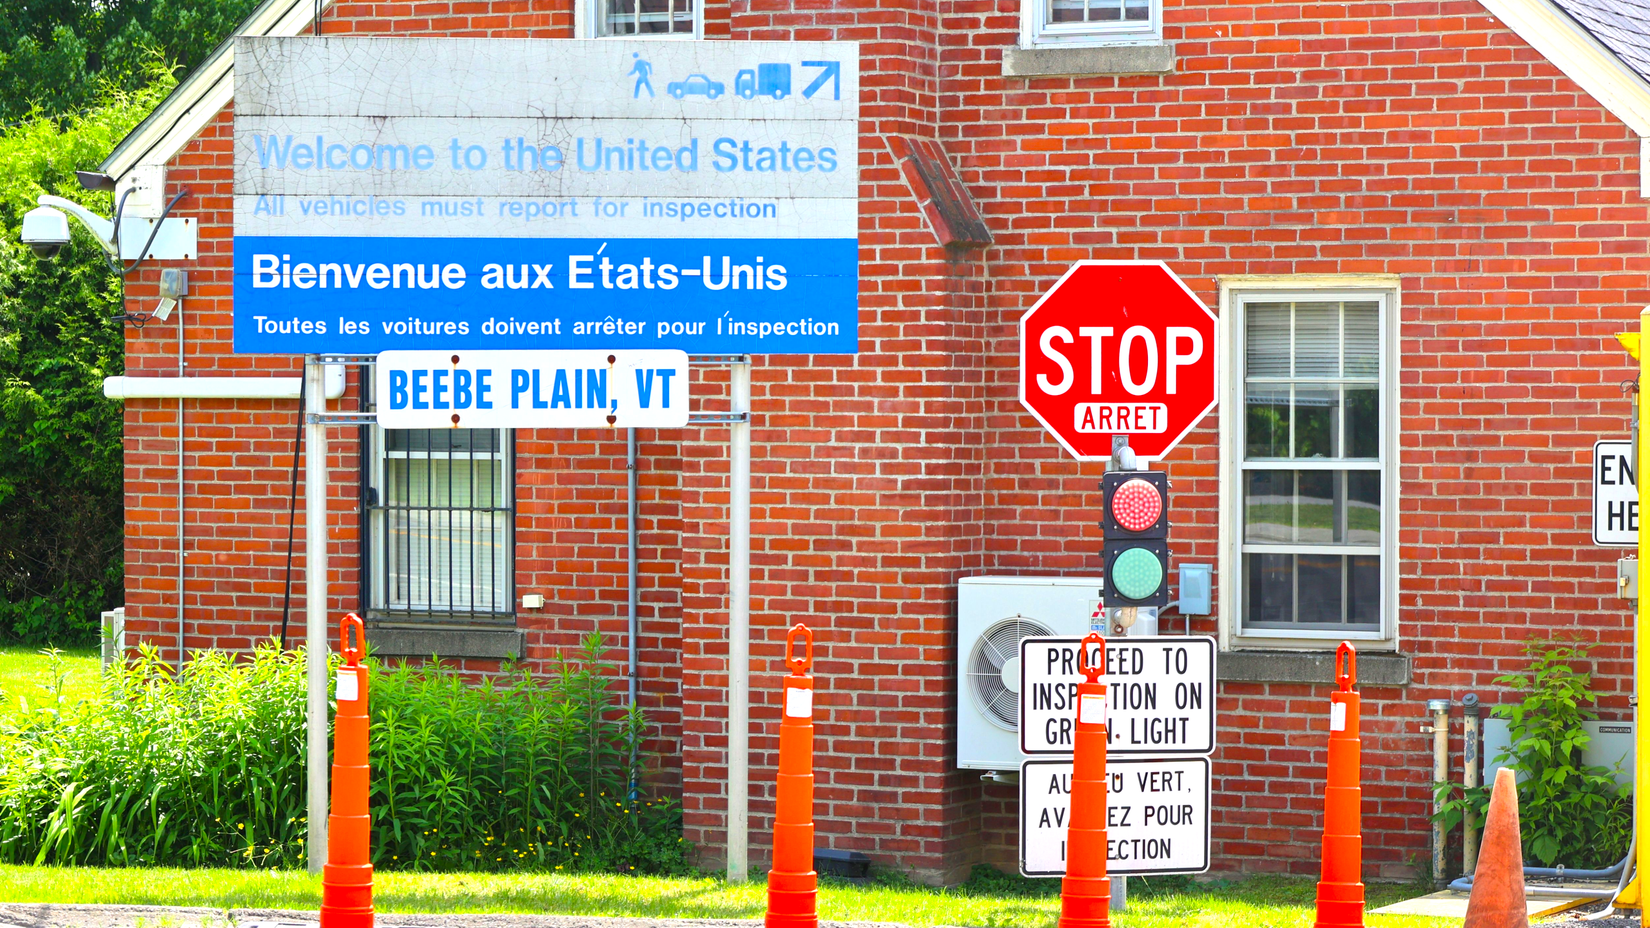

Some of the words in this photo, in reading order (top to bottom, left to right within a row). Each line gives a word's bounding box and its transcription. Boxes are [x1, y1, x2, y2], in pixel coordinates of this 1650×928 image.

[252, 134, 435, 172] Welcome
[448, 137, 488, 172] to
[501, 137, 563, 172] the
[576, 137, 698, 173] United
[712, 137, 838, 173] States
[253, 195, 285, 217] All
[299, 195, 406, 217] vehicles
[421, 197, 485, 218] must
[499, 197, 578, 223] report
[593, 196, 629, 218] for
[643, 197, 777, 223] inspection
[252, 253, 466, 290] Bienvenue
[481, 263, 553, 290] aux
[253, 316, 327, 335] Toutes
[339, 316, 370, 335] les
[382, 316, 470, 335] voitures
[481, 317, 561, 335] doivent
[573, 315, 646, 335] arrêter
[657, 321, 706, 339] pour
[1036, 325, 1204, 396] STOP
[389, 370, 493, 410] BEEBE
[511, 369, 618, 416] PLAIN,
[635, 369, 676, 408] VT
[1081, 405, 1161, 430] ARRET
[1600, 455, 1636, 485] EN
[1607, 500, 1639, 531] HE
[1163, 647, 1188, 675] TO
[1033, 682, 1157, 711] INSPTION
[1175, 682, 1202, 710] ON
[1130, 717, 1189, 745] LIGHT
[1136, 771, 1192, 794] VERT,
[1039, 806, 1131, 829] AVEZ
[1144, 805, 1193, 827] POUR
[1061, 838, 1171, 861] IECTION
